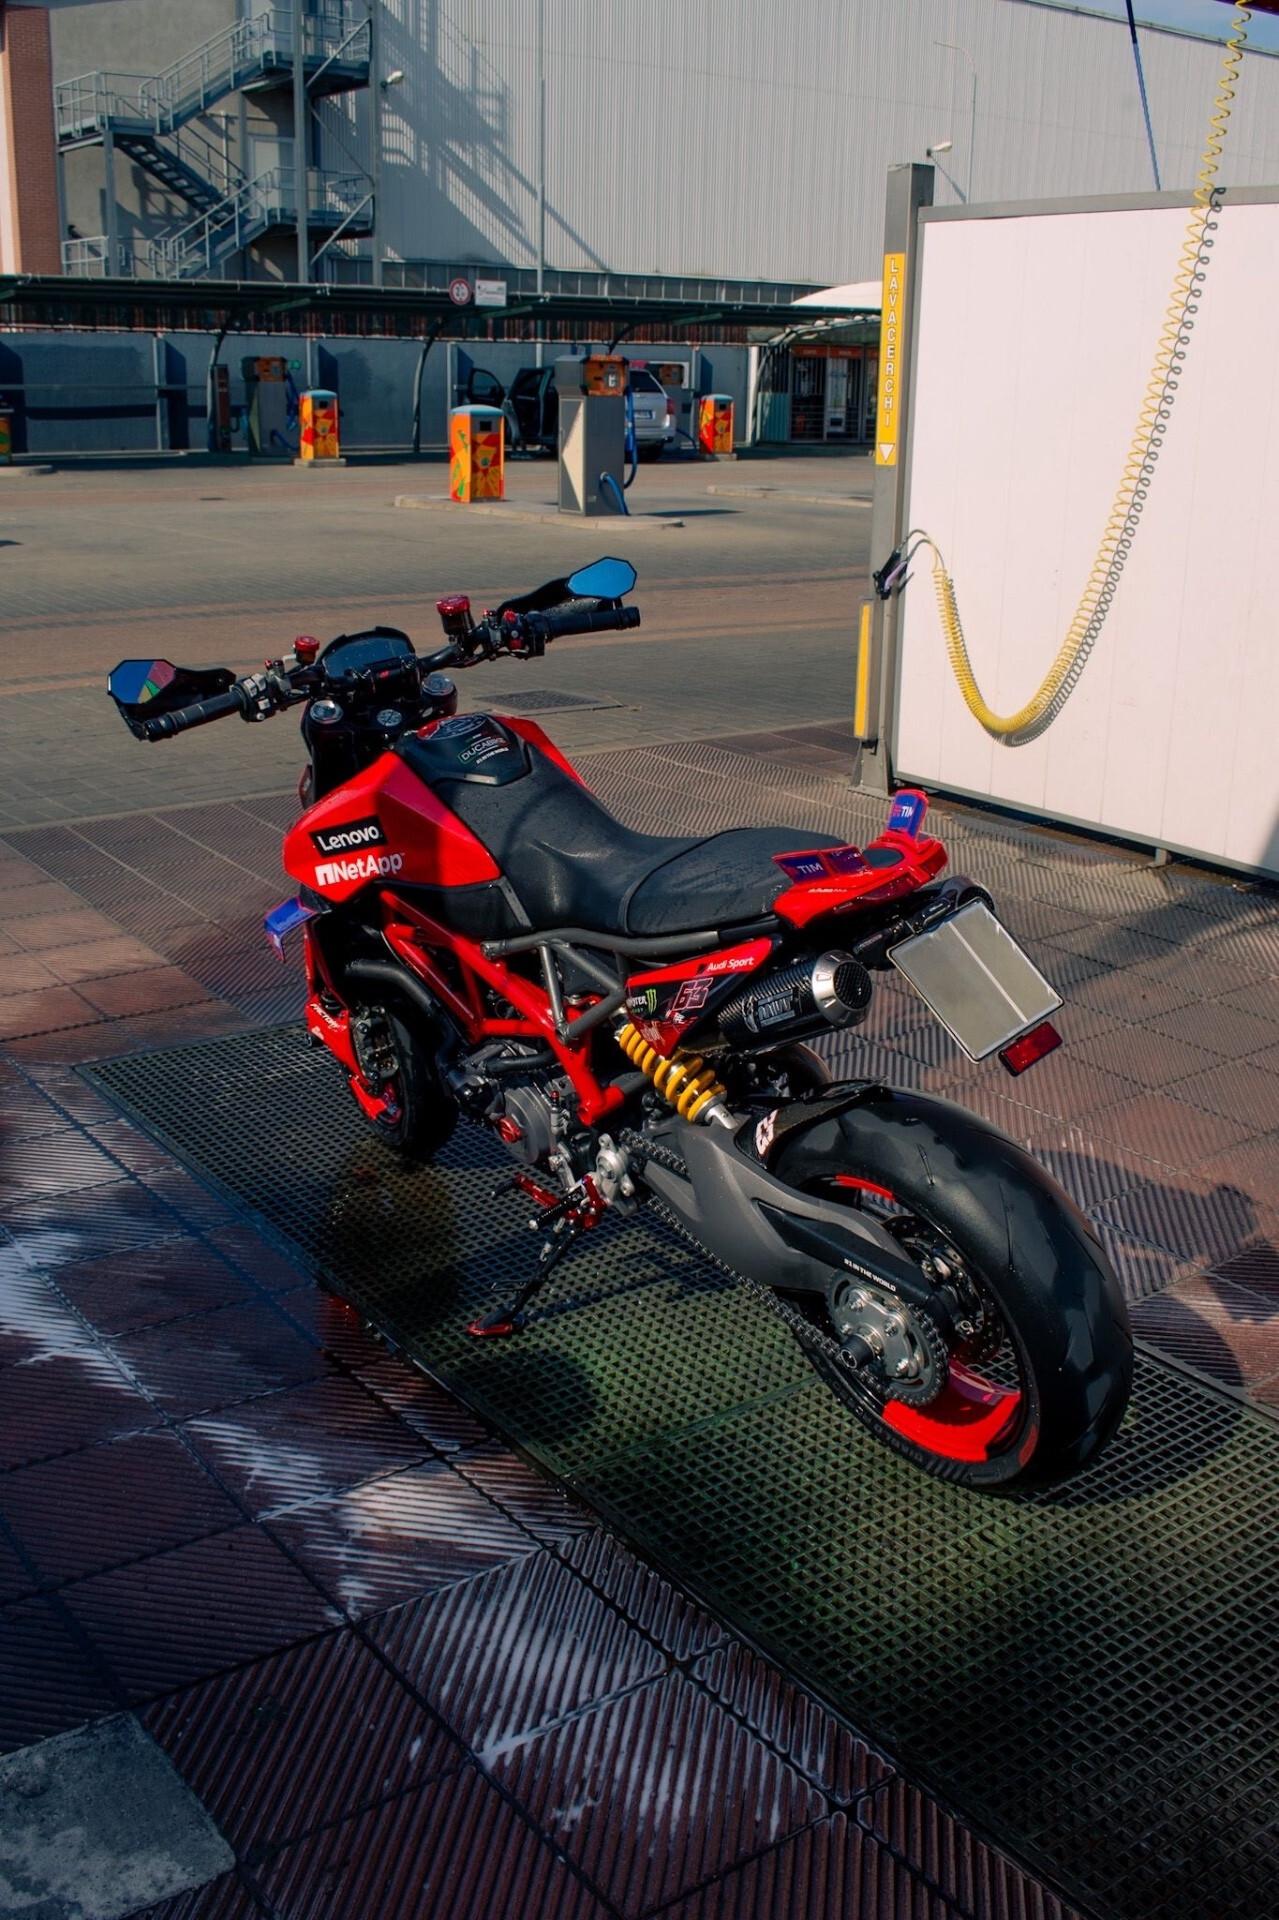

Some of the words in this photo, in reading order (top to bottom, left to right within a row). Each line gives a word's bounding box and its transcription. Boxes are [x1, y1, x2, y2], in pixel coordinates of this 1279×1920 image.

[884, 257, 899, 427] LAVACERCHI
[317, 825, 380, 851] Lenovo
[334, 853, 404, 882] NetApp
[797, 861, 824, 875] TIM
[707, 961, 727, 972] Audi
[727, 956, 755, 970] Sport
[672, 977, 713, 1012] 63
[859, 1266, 873, 1279] THE
[872, 1274, 897, 1292] WORLD
